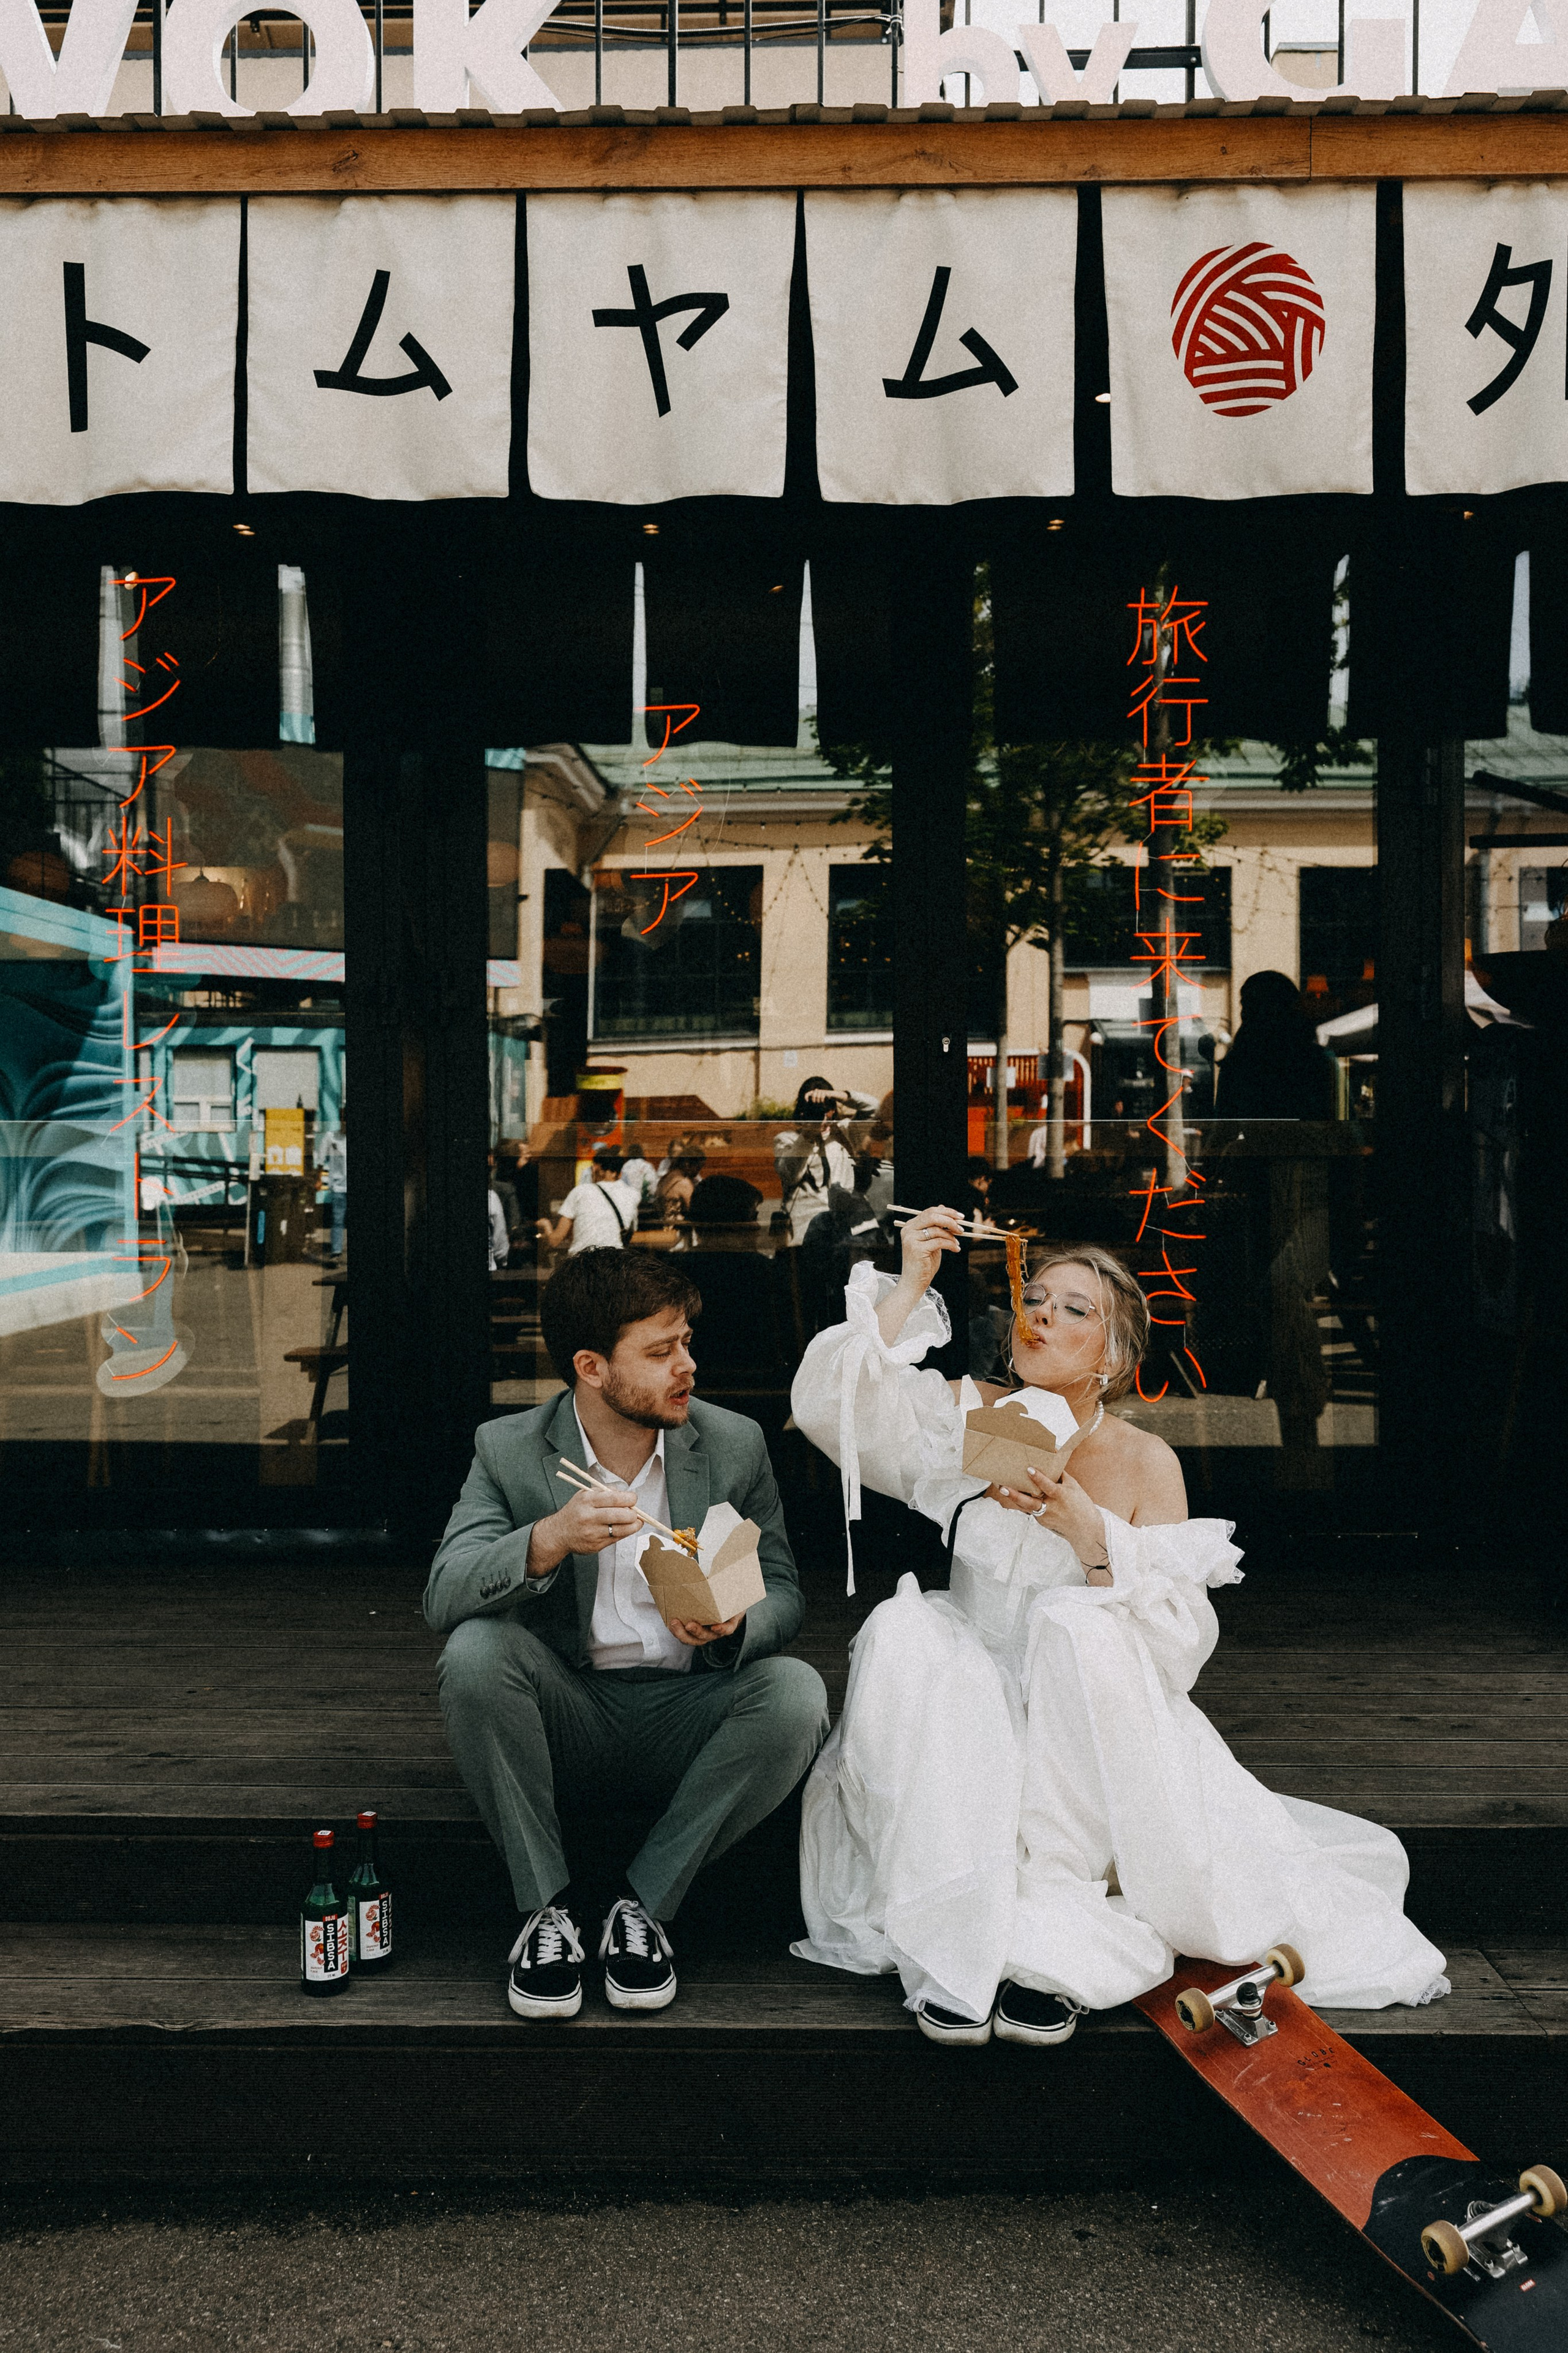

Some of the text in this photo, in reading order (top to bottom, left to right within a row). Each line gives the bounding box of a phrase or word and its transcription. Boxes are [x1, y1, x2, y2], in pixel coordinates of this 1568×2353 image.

[630, 704, 703, 935] アジア
[326, 1924, 336, 1970] SIBSA
[1297, 2047, 1335, 2066] GLOBE
